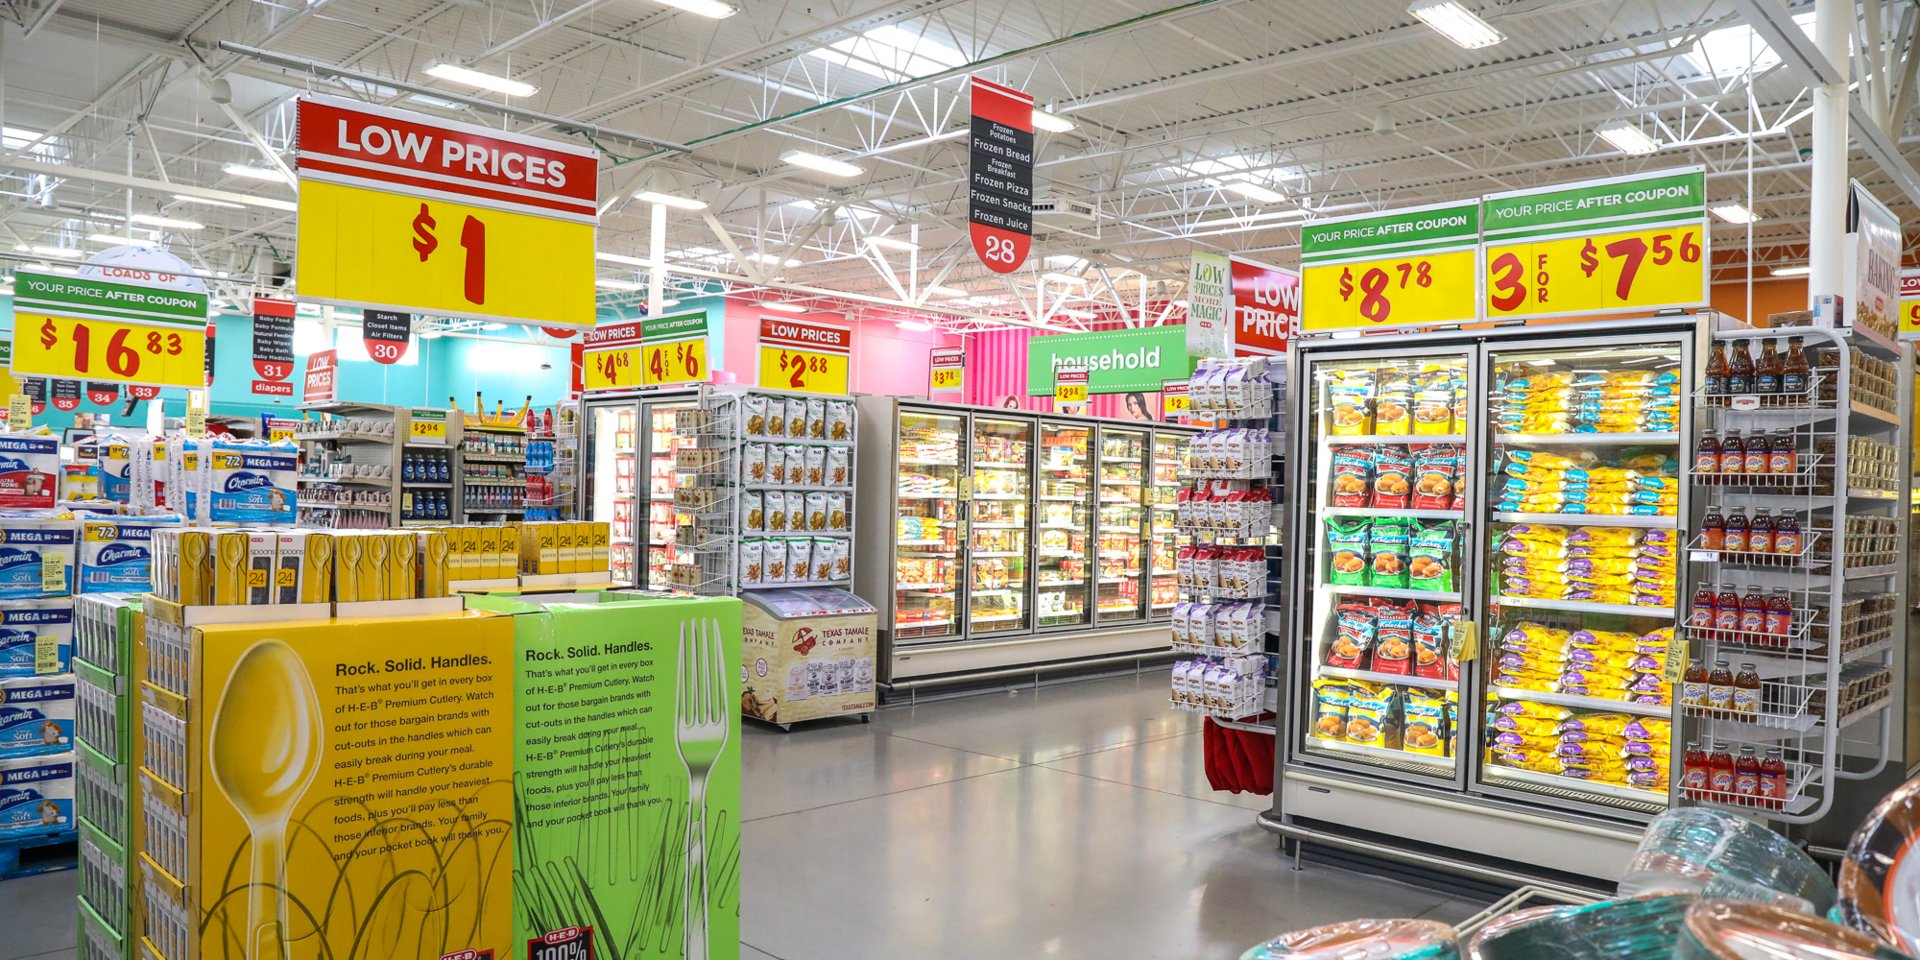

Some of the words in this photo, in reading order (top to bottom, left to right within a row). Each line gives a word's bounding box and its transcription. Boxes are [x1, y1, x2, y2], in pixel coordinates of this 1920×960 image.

[993, 123, 1013, 135] Frozen
[990, 130, 1016, 144] Potatoes
[338, 119, 432, 163] LOW
[442, 140, 566, 188] PRICES
[974, 138, 1003, 154] Frozen
[1006, 148, 1030, 163] Bread
[992, 158, 1012, 170] Frozen
[988, 165, 1016, 178] Breakfast
[975, 173, 1004, 189] Frozen
[1007, 182, 1029, 196] Pizza
[971, 190, 1000, 205] Frozen
[1003, 199, 1031, 214] Snacks
[1496, 206, 1531, 219] YOUR
[1535, 201, 1573, 213] PRICE
[1576, 195, 1621, 209] AFTER
[1625, 185, 1689, 203] COUPON
[974, 210, 1003, 224] Frozen
[1006, 217, 1028, 230] Juice
[1312, 232, 1340, 243] YOUR
[1344, 228, 1374, 238] PRICE
[1377, 222, 1412, 235] AFTER
[1416, 216, 1467, 229] COUPON
[985, 236, 1015, 263] 28
[1195, 263, 1225, 284] LOW
[1868, 248, 1895, 299] BAKING
[1491, 253, 1527, 311] 3
[1537, 254, 1549, 303] FOR
[28, 280, 64, 294] YOUR
[68, 284, 103, 298] PRICE
[106, 291, 144, 303] AFTER
[147, 296, 196, 310] COUPON
[1193, 282, 1223, 298] PRICES
[1254, 277, 1299, 311] LOW
[1193, 295, 1222, 306] MORE
[260, 315, 273, 323] Baby
[1191, 303, 1222, 321] MAGIC
[367, 322, 387, 330] Closet
[645, 323, 656, 332] YOUR
[657, 322, 669, 330] PRICE
[670, 320, 684, 328] AFTER
[684, 318, 703, 327] COUPON
[1243, 305, 1299, 339] PRICE
[590, 330, 607, 341] LOW
[608, 326, 635, 339] PRICES
[772, 324, 798, 339] LOW
[801, 328, 840, 344] PRICES
[257, 338, 271, 346] Baby
[374, 344, 397, 359] 30
[312, 355, 329, 371] LOW
[650, 348, 663, 381] 4
[1051, 346, 1160, 374] household
[264, 365, 283, 377] 31
[307, 371, 331, 388] PRICES
[136, 387, 152, 397] 33
[255, 382, 291, 394] diapers
[58, 400, 73, 408] 35
[95, 393, 110, 402] 34
[226, 456, 240, 466] 72
[228, 476, 263, 489] Charmin
[98, 526, 115, 538] 72
[122, 529, 150, 537] MEGA
[463, 541, 476, 552] 24
[502, 540, 514, 551] 24
[541, 537, 553, 547] 24
[102, 548, 141, 562] Charmin
[249, 573, 264, 584] 24
[278, 572, 293, 584] 24
[9, 612, 40, 621] MEGA
[743, 628, 754, 636] EXAS
[756, 629, 774, 640] TAMALE
[822, 629, 842, 638] TEXAS
[845, 627, 869, 635] TAMALE
[10, 654, 28, 662] Soft
[526, 649, 564, 661] Rock.
[567, 645, 601, 658] Solid.
[604, 641, 653, 655] Handles.
[336, 662, 380, 676] Rock.
[385, 658, 425, 672] Solid.
[431, 654, 491, 669] Handles.
[526, 670, 552, 679] That's
[555, 668, 573, 677] what
[575, 665, 596, 675] you'll
[597, 663, 609, 672] get
[611, 662, 617, 670] in
[619, 659, 638, 669] every
[640, 658, 654, 666] box
[336, 684, 365, 695] That's
[368, 683, 391, 692] what
[394, 680, 419, 693] you'll
[422, 679, 436, 690] get
[439, 677, 447, 686] in
[450, 675, 473, 687] every
[476, 674, 492, 683] box
[11, 690, 42, 699] MEGA
[14, 731, 32, 739] Soft
[8, 771, 39, 781] MEGA
[11, 812, 31, 822] Soft
[549, 929, 575, 941] H-E-B
